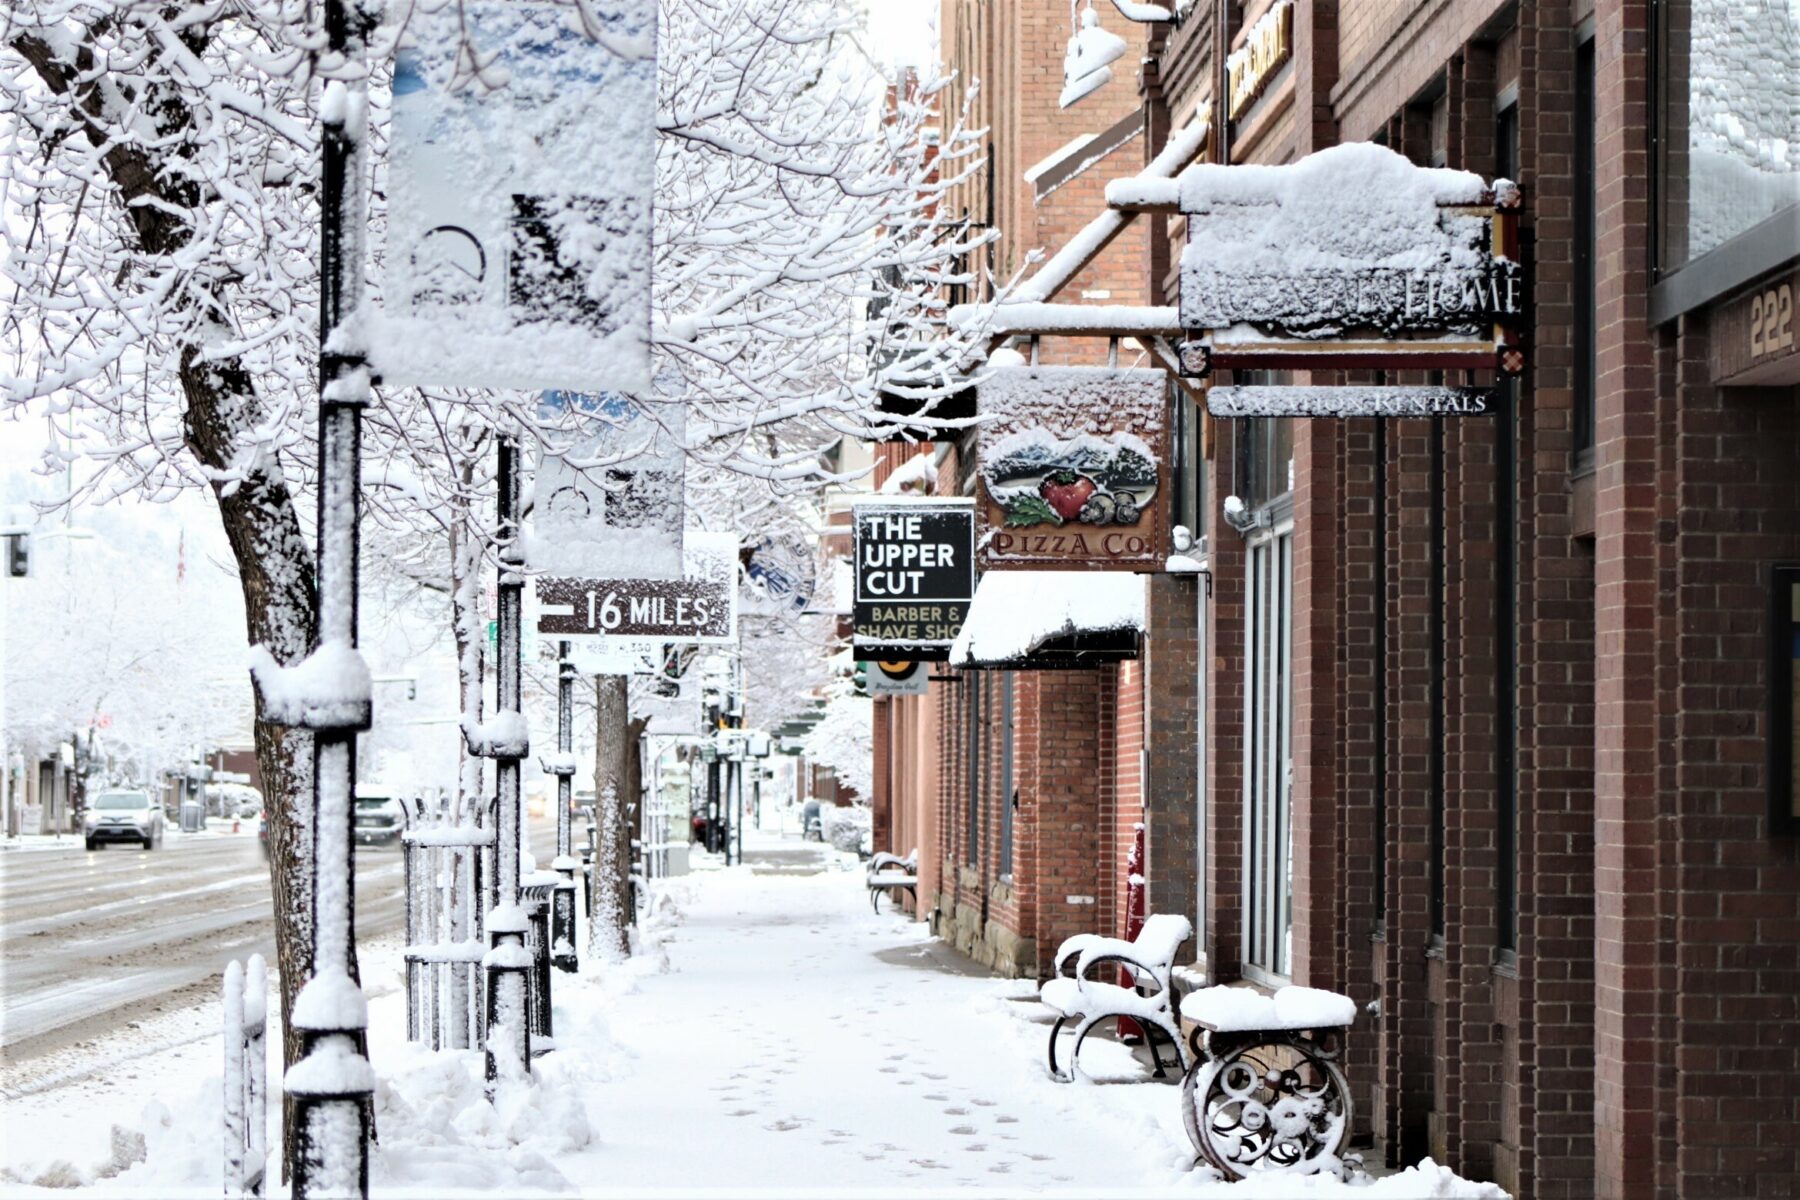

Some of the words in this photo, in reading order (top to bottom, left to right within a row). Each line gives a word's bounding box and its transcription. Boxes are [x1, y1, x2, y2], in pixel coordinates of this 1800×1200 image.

[1403, 271, 1522, 319] HOME
[1751, 285, 1793, 358] 222
[865, 517, 922, 540] THE
[865, 543, 954, 568] UPPER
[990, 532, 1091, 556] PIZZA
[866, 570, 925, 595] CUT
[586, 590, 622, 630] 16
[629, 597, 709, 627] MILES
[872, 606, 942, 622] BARBER
[948, 606, 960, 622] &
[857, 624, 919, 640] SHAVE
